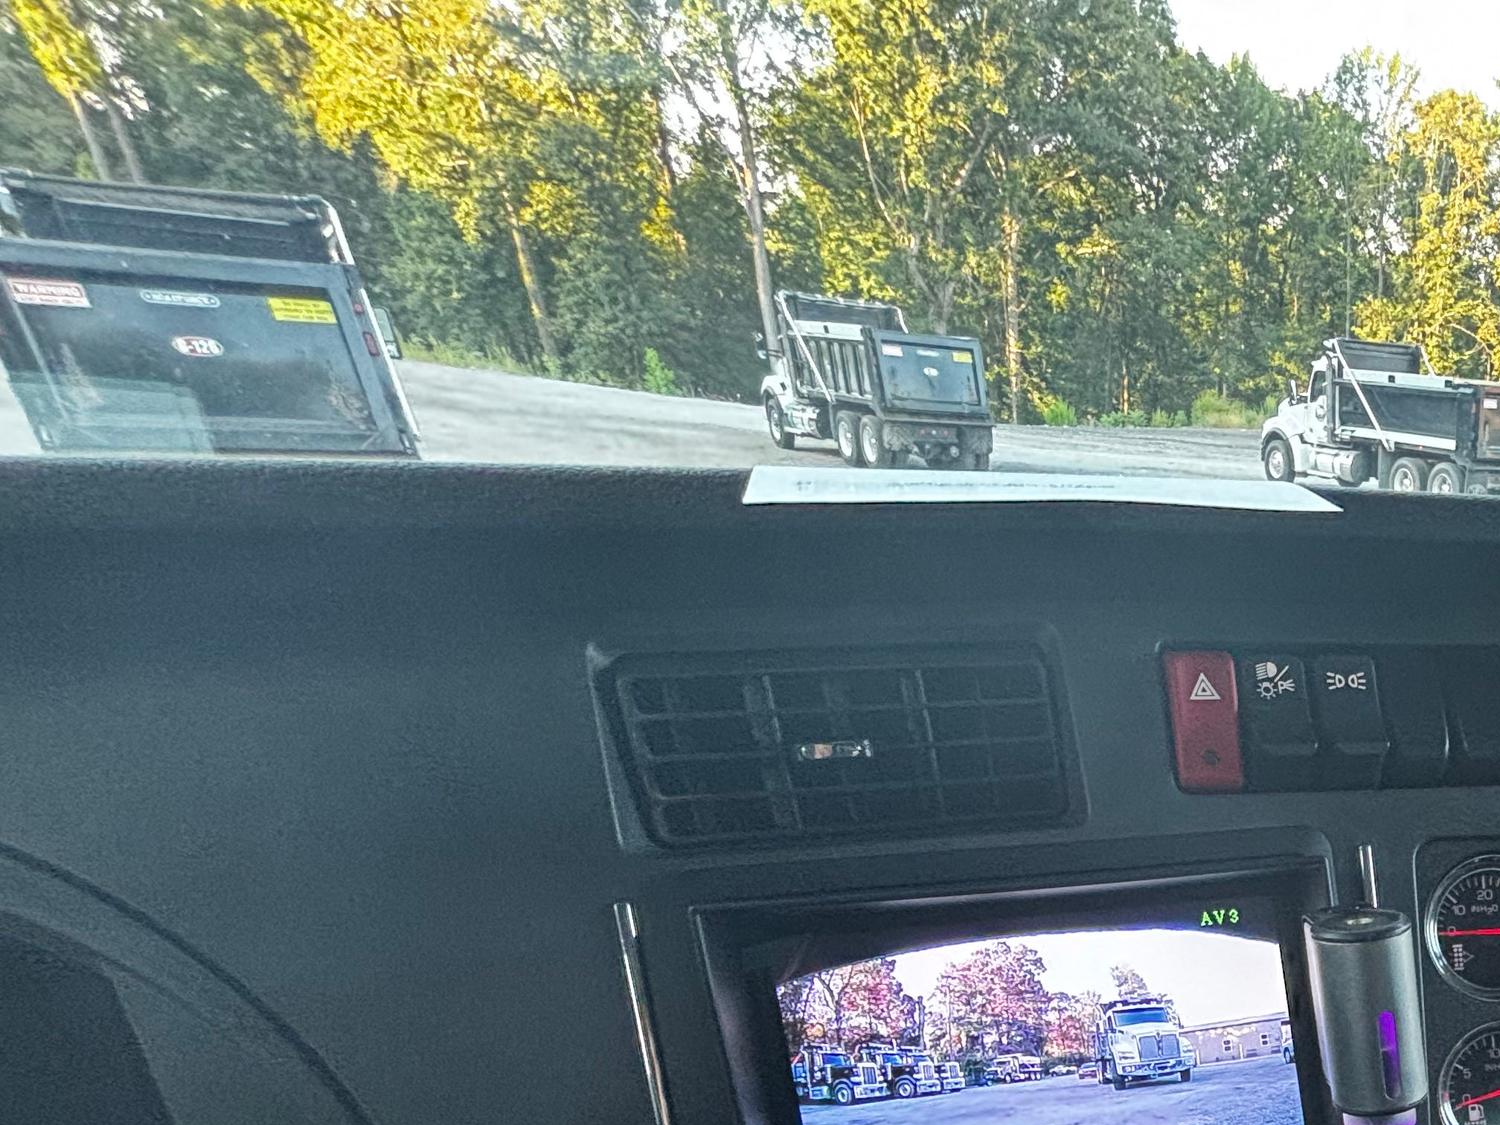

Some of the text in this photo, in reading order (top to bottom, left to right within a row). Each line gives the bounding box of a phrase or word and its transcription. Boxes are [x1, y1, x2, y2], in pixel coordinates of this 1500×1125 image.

[1476, 889, 1493, 901] 20
[1452, 904, 1466, 916] 10
[1462, 1068, 1472, 1080] 5
